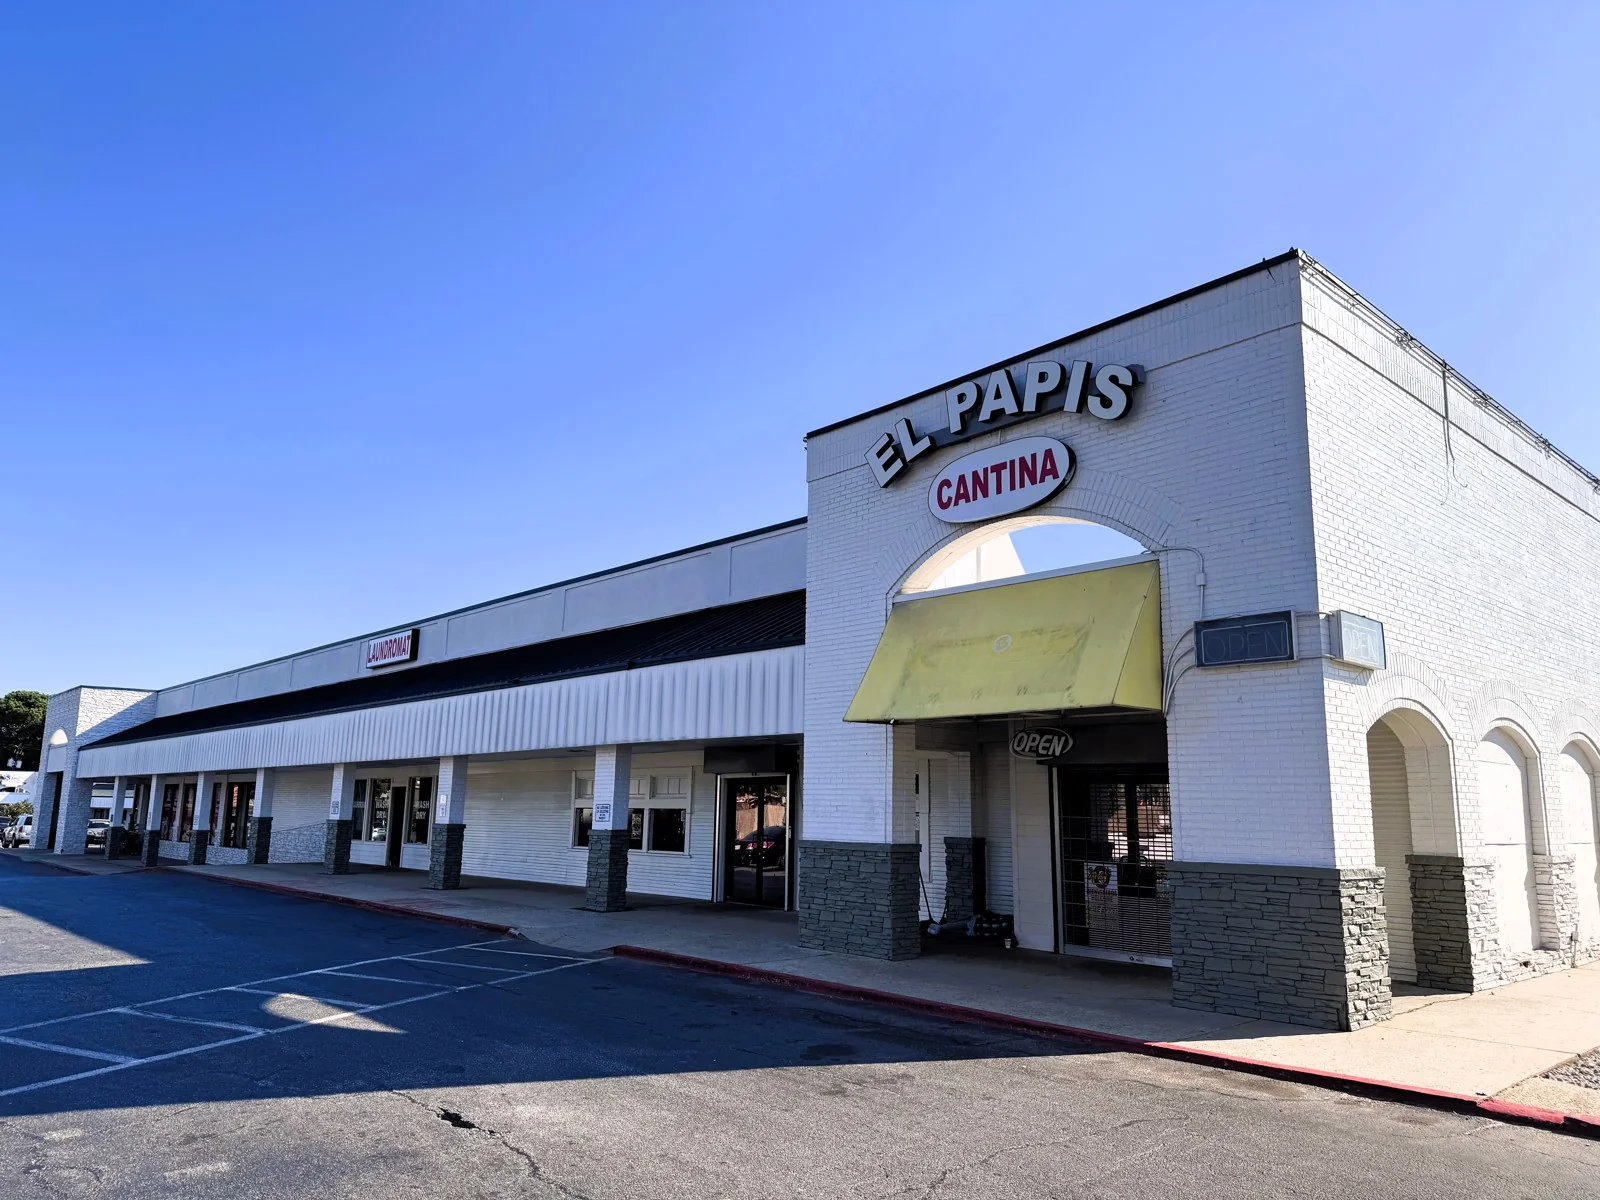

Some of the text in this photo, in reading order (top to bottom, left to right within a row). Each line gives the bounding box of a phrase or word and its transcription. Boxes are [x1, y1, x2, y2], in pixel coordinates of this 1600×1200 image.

[864, 360, 1136, 488] EL PAPIS
[936, 448, 1060, 510] CANTINA
[367, 635, 411, 663] LAUNDROMAT
[1205, 629, 1285, 662] OPEN
[1342, 628, 1377, 662] OPEN
[1013, 732, 1066, 757] OPEN
[415, 811, 427, 820] DRY
